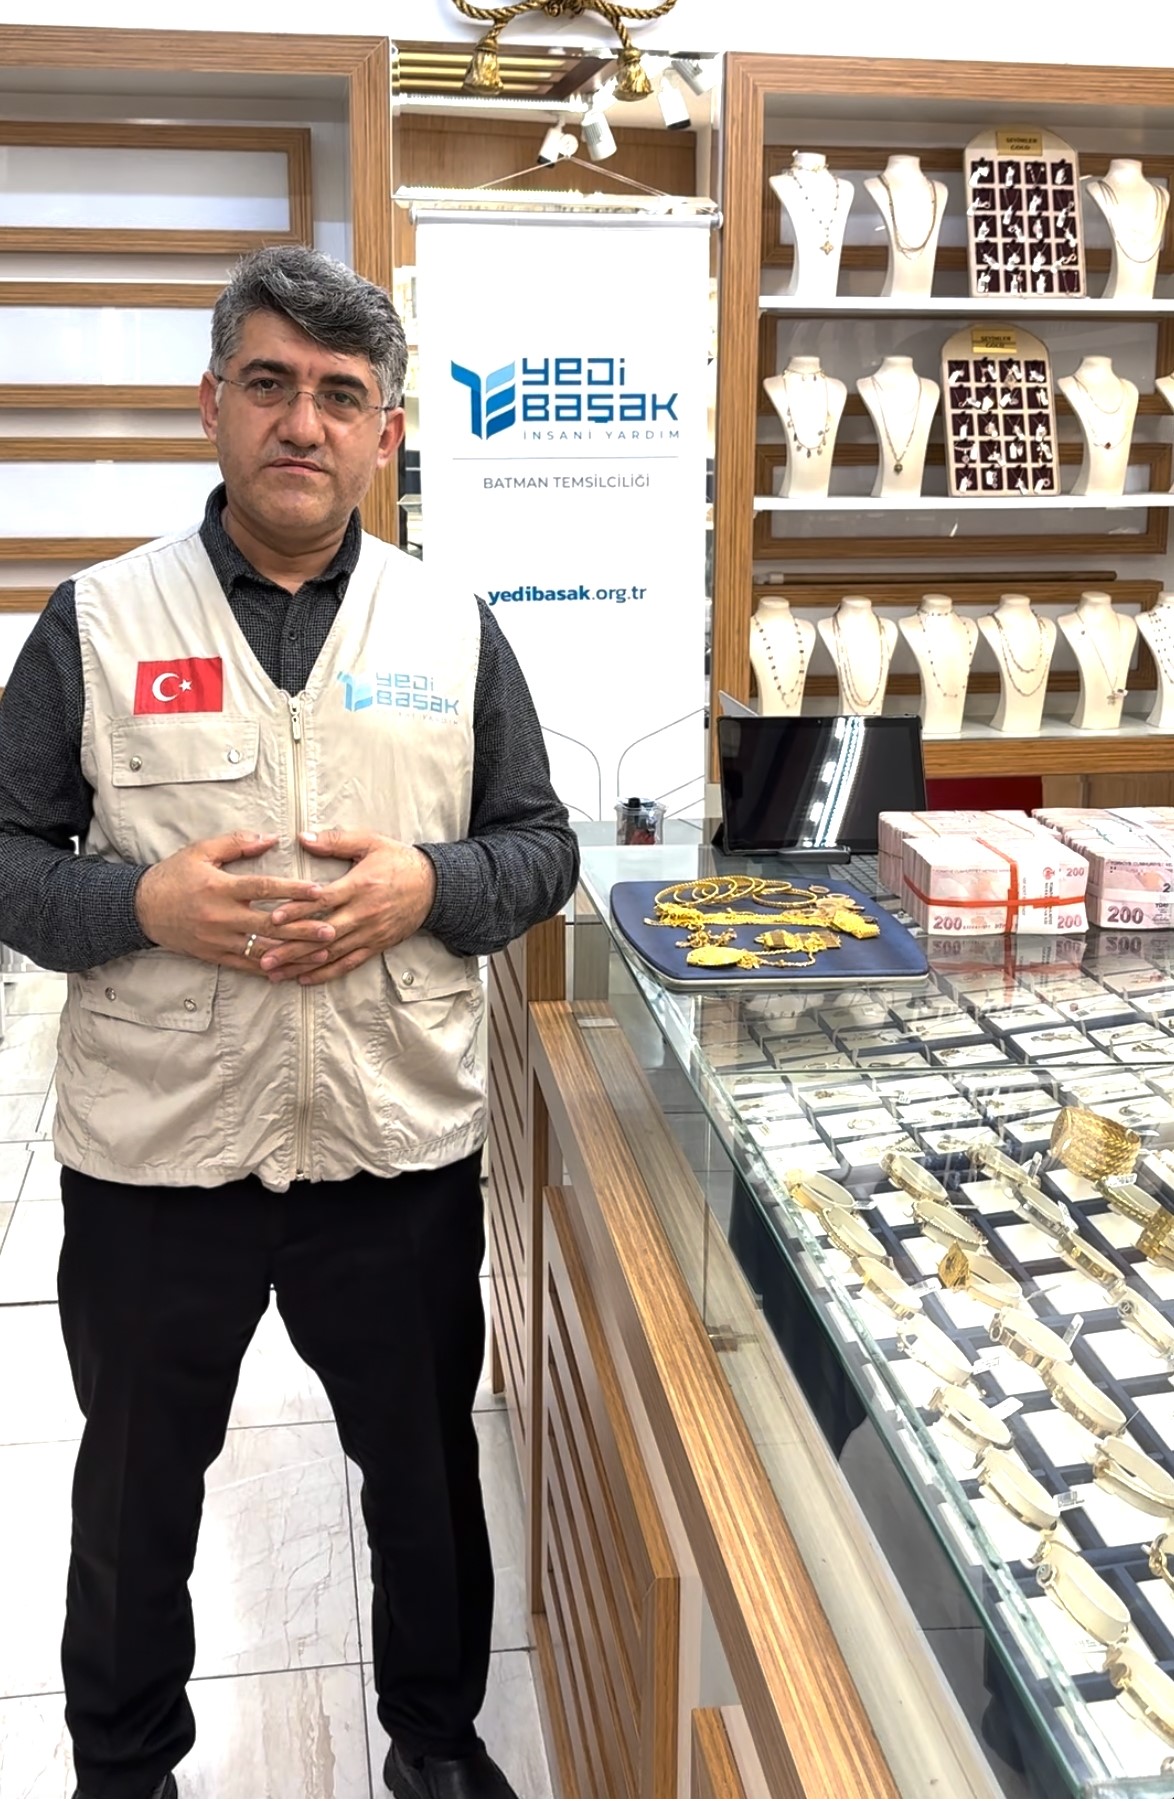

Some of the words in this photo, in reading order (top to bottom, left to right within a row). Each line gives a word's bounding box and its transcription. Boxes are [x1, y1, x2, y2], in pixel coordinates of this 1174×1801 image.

[523, 430, 592, 440] İNSANİ
[605, 430, 680, 440] YARDIM
[483, 477, 549, 489] BATMAN
[553, 473, 650, 488] TEMSİLCİLİĞİ
[488, 585, 647, 605] yedibasak.org.tr
[1066, 867, 1085, 877] 200
[1057, 915, 1082, 929] 200
[1107, 905, 1144, 924] 200
[933, 916, 962, 931] 200
